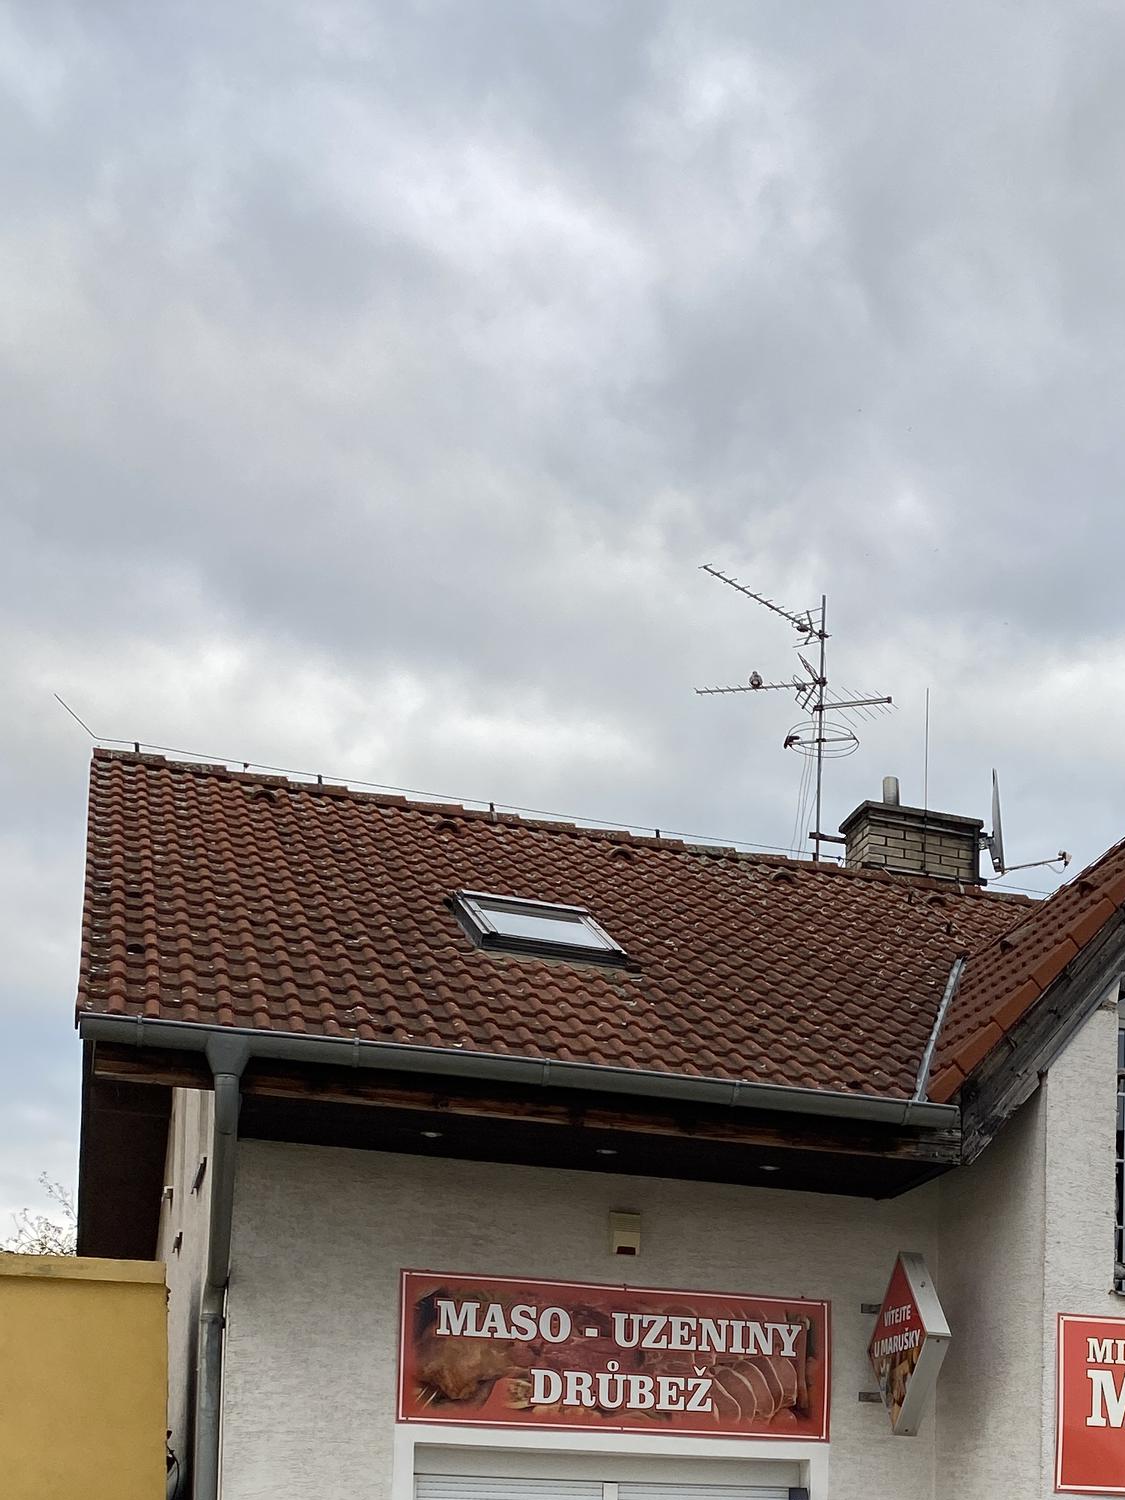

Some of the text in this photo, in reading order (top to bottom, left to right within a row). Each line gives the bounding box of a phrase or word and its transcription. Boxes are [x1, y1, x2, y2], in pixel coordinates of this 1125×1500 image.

[435, 1299, 571, 1343] MASO
[612, 1311, 804, 1357] UZENINY
[884, 1304, 912, 1327] VÍTEJTE
[874, 1327, 920, 1357] U MARUŠKY
[530, 1360, 714, 1412] DRŮBEŽ
